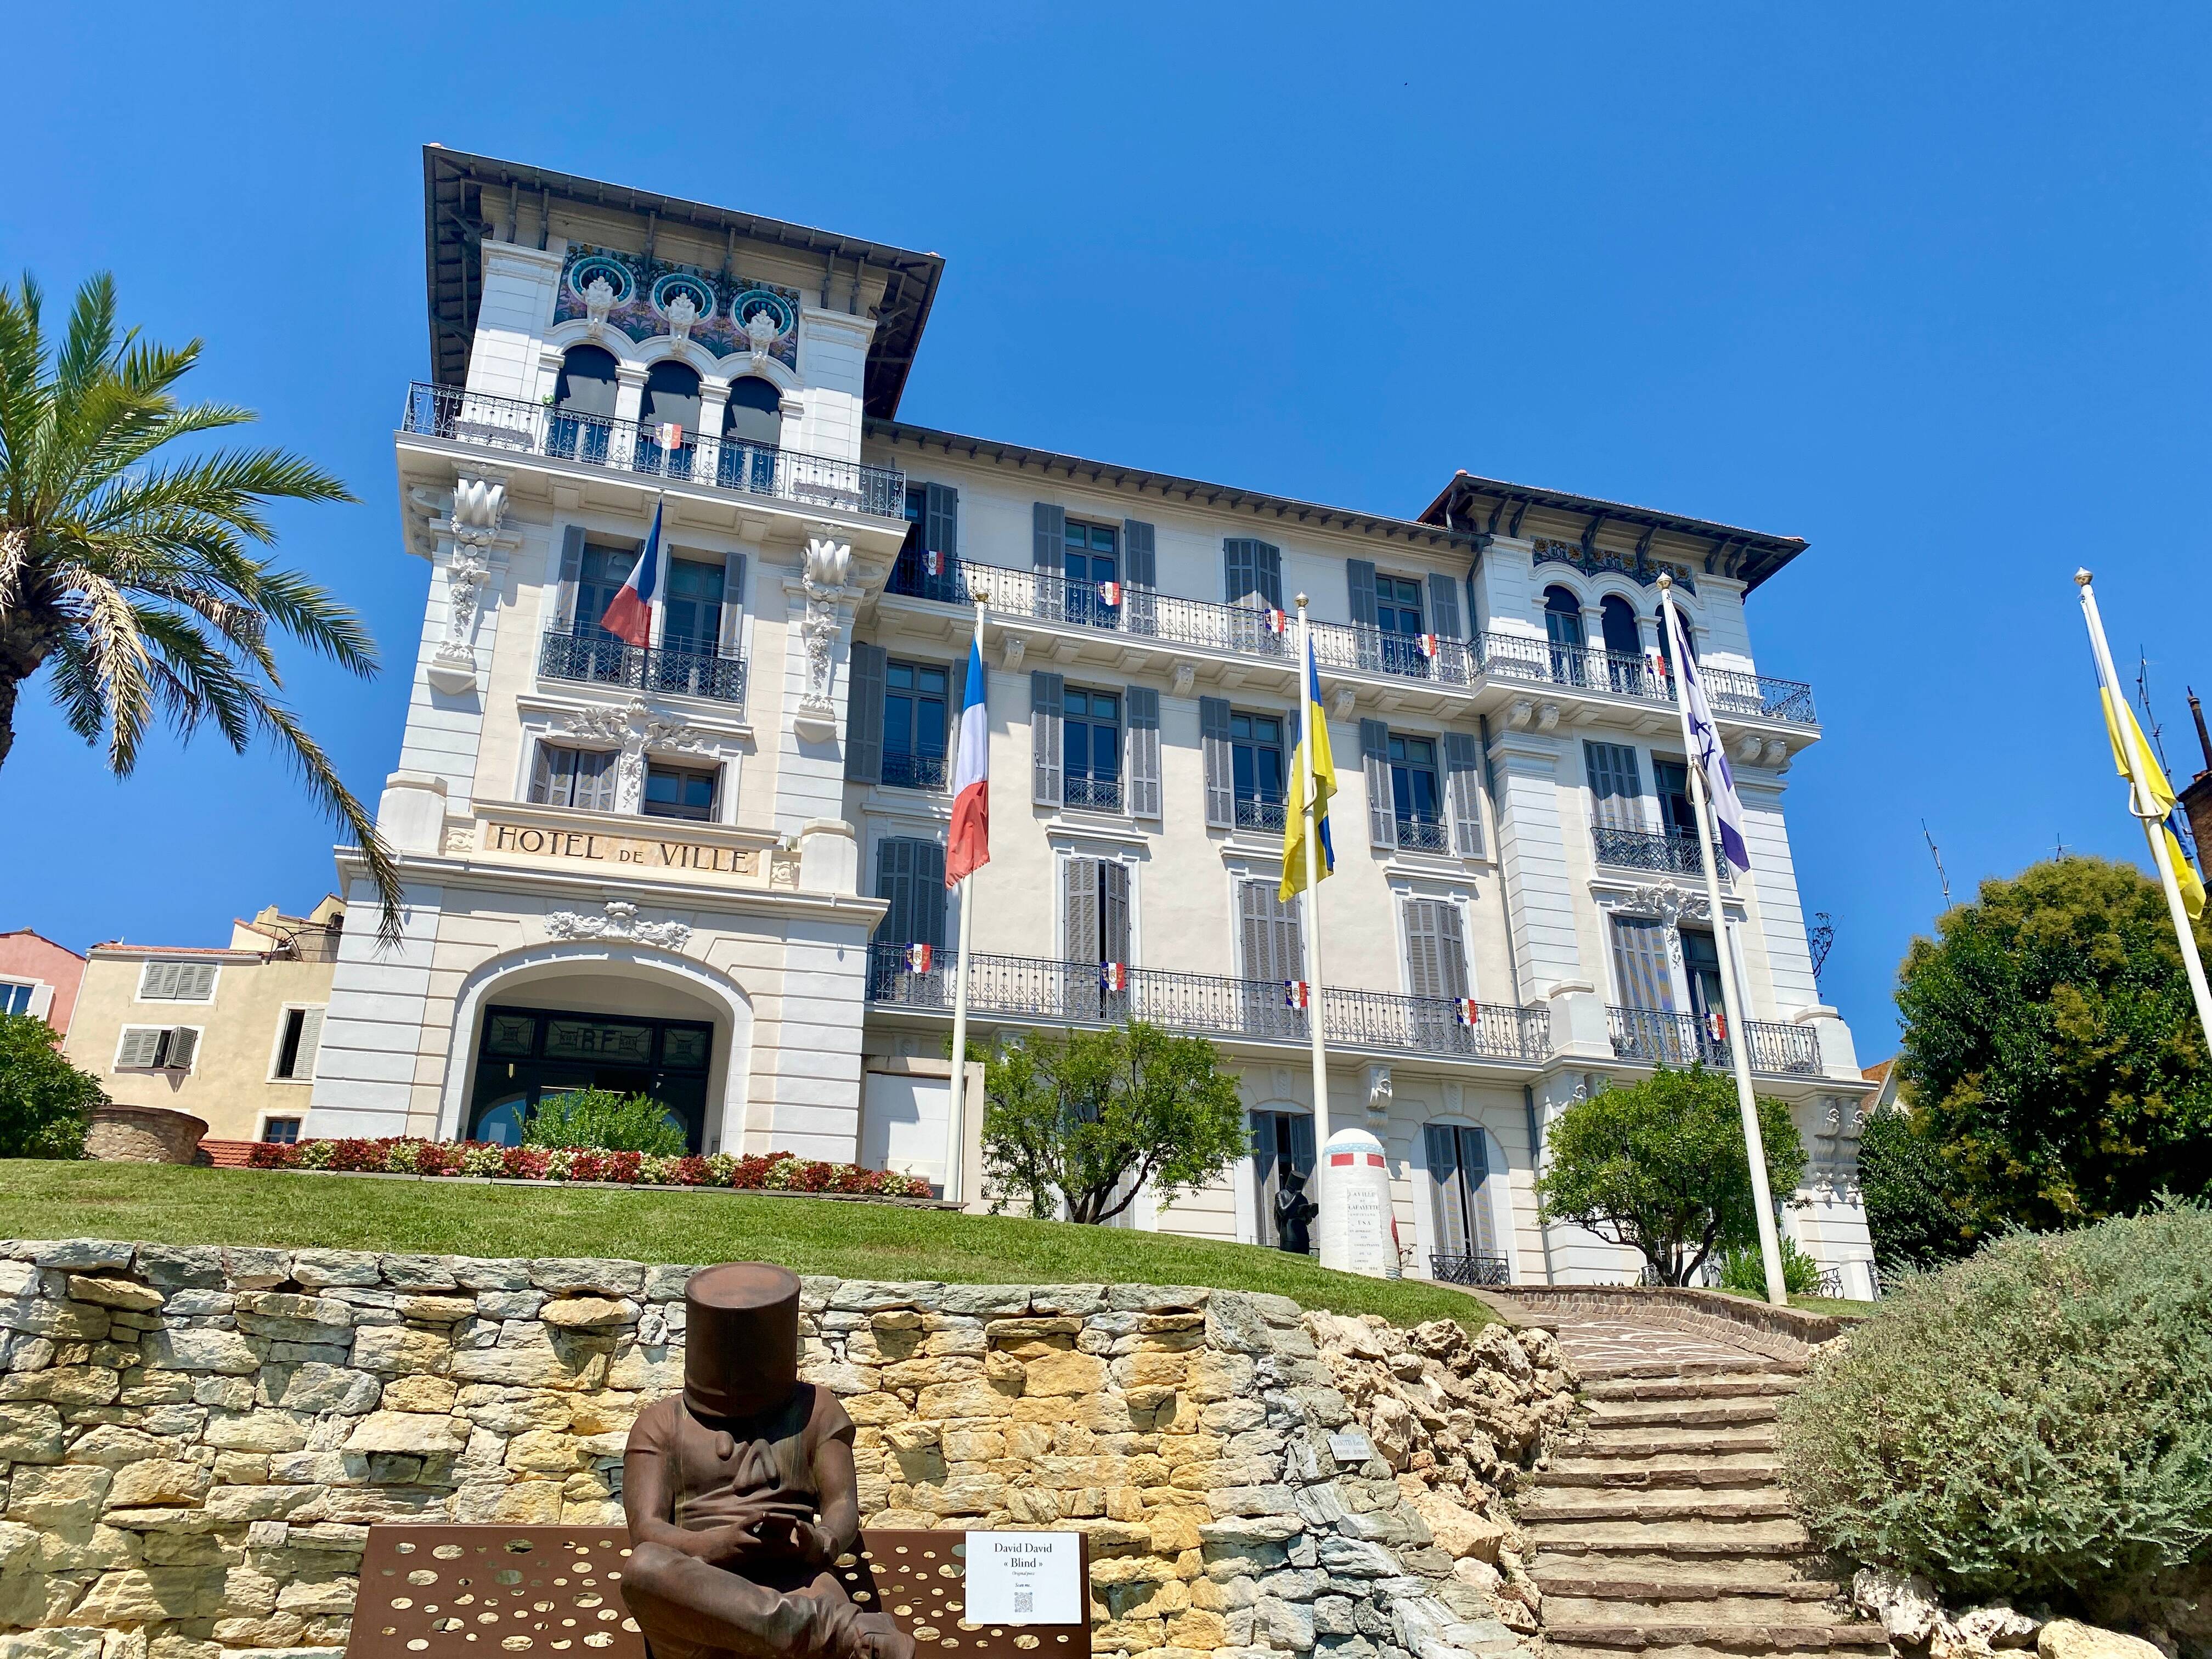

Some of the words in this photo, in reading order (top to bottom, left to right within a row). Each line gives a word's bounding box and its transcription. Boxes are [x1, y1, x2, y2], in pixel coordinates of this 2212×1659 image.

[496, 826, 604, 860] HOTEL
[619, 849, 644, 864] DE
[660, 843, 749, 873] VILLE
[995, 1543, 1022, 1553] David
[1025, 1543, 1052, 1553] David
[1011, 1558, 1036, 1567] Blind
